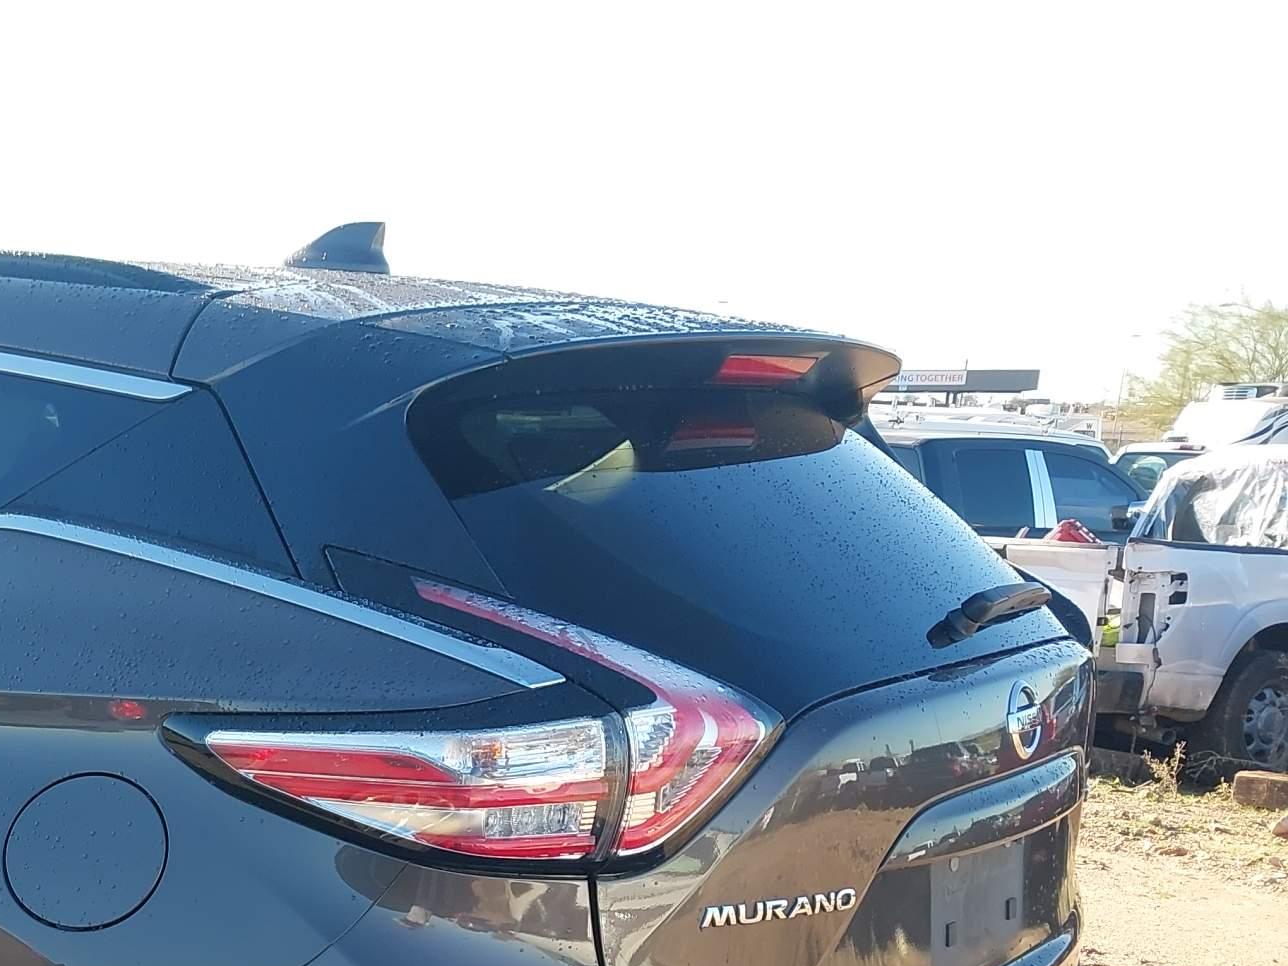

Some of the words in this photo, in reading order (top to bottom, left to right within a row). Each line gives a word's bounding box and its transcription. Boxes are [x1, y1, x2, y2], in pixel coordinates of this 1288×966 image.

[894, 374, 914, 382] ING
[915, 374, 964, 382] TOGETHER
[1016, 708, 1040, 728] NISS
[701, 888, 857, 928] MURANO
